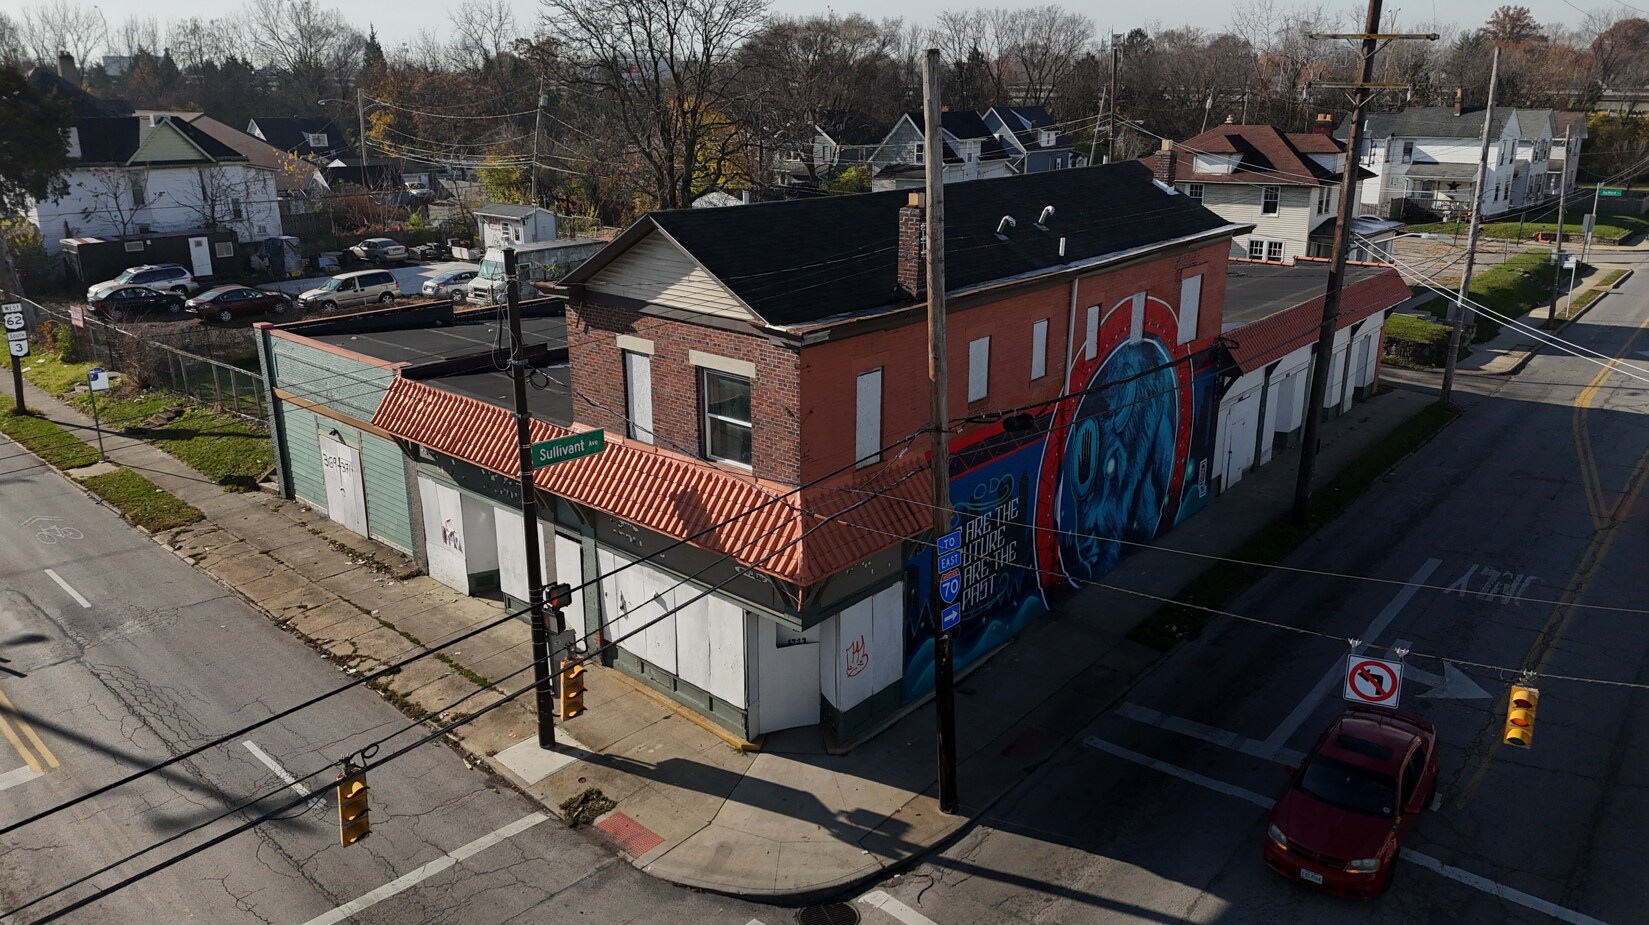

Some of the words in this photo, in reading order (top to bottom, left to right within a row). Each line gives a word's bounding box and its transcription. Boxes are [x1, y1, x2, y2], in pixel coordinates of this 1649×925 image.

[7, 315, 22, 325] 62
[15, 343, 23, 352] 3
[540, 440, 585, 461] Sullivant
[588, 439, 598, 447] Ave
[966, 511, 992, 543] ARE
[995, 498, 1018, 526] THE
[943, 538, 955, 549] TO
[957, 526, 1006, 567] UTURE
[941, 555, 958, 569] EAST
[964, 556, 989, 588] ARE
[994, 540, 1017, 570] THE
[942, 578, 958, 597] 70
[962, 573, 997, 611] PAST
